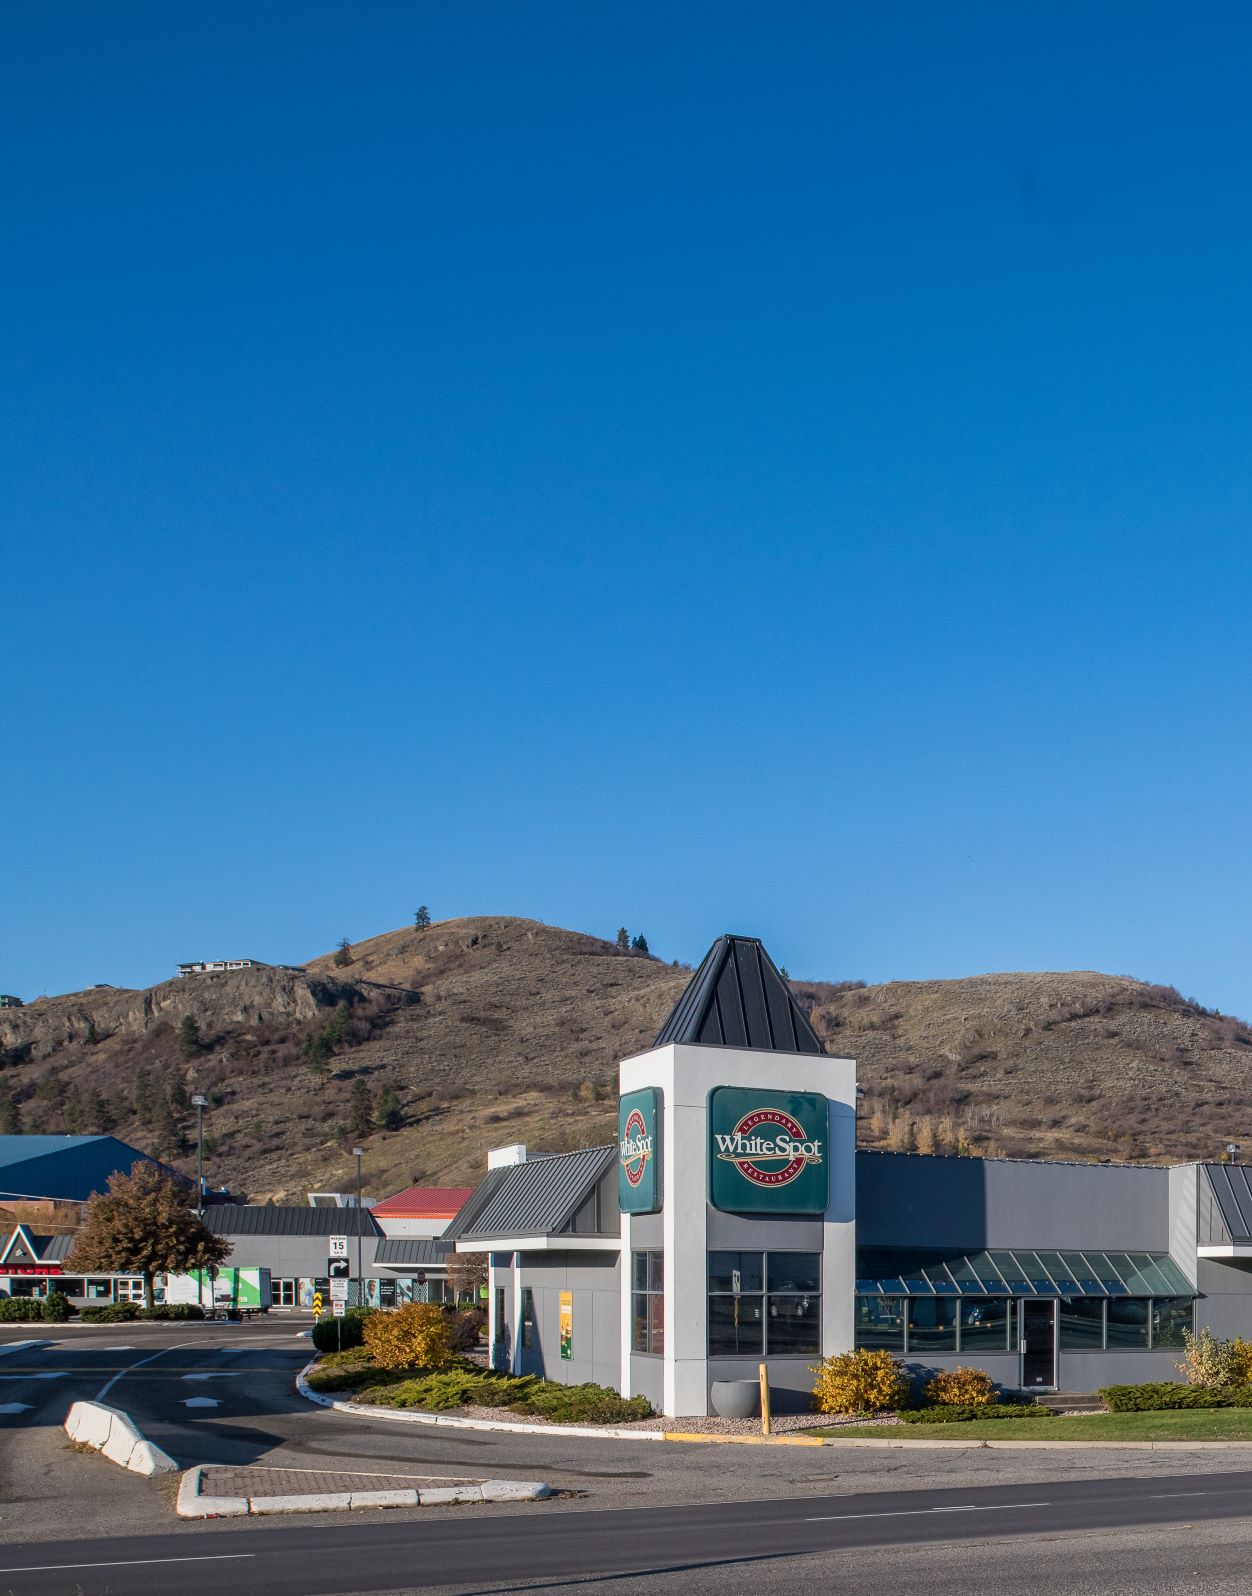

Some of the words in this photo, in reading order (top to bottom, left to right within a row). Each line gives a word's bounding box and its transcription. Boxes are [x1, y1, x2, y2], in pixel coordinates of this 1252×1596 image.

[743, 1114, 798, 1133] LEGENDARY
[743, 1163, 798, 1182] RESTAURANT
[333, 1241, 344, 1250] 15
